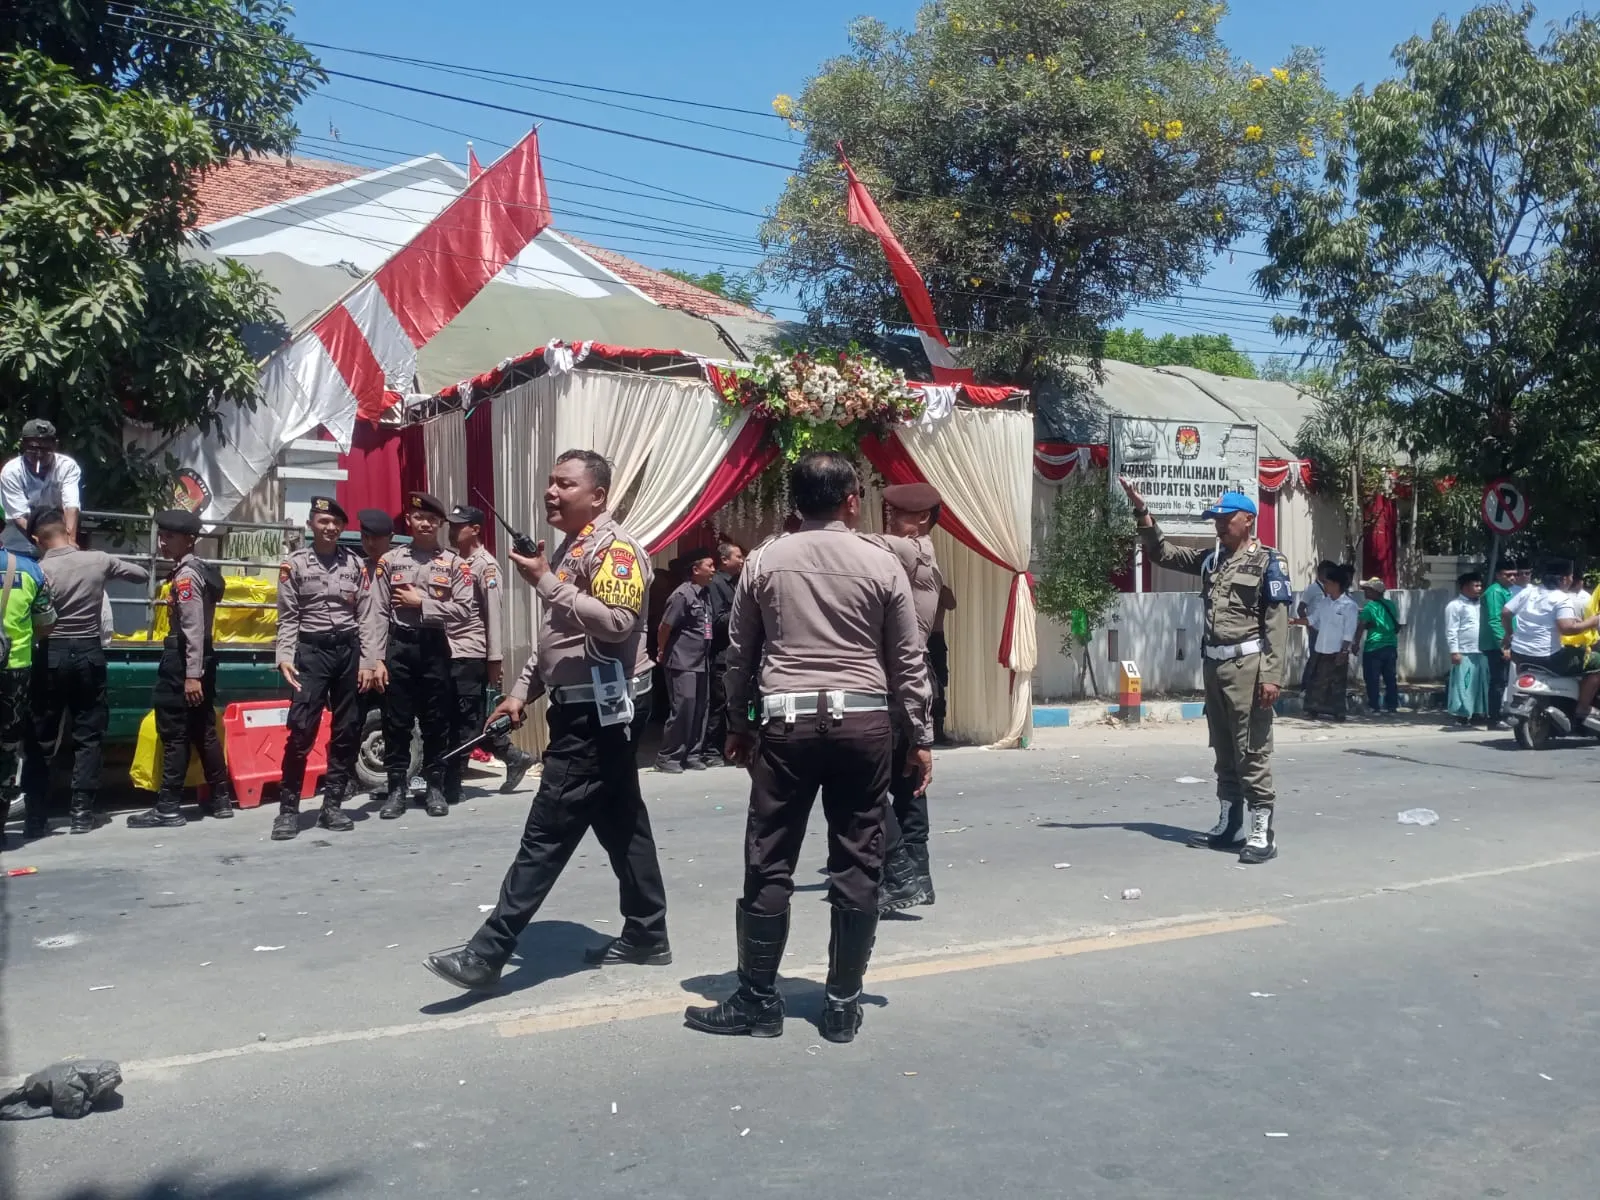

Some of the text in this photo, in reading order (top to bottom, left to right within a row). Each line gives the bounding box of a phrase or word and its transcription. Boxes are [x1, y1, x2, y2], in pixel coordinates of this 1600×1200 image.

[1161, 465, 1216, 482] PEMILIHAN
[1132, 482, 1245, 498] KABUPATEN SAMPAG
[1127, 663, 1137, 676] 4
